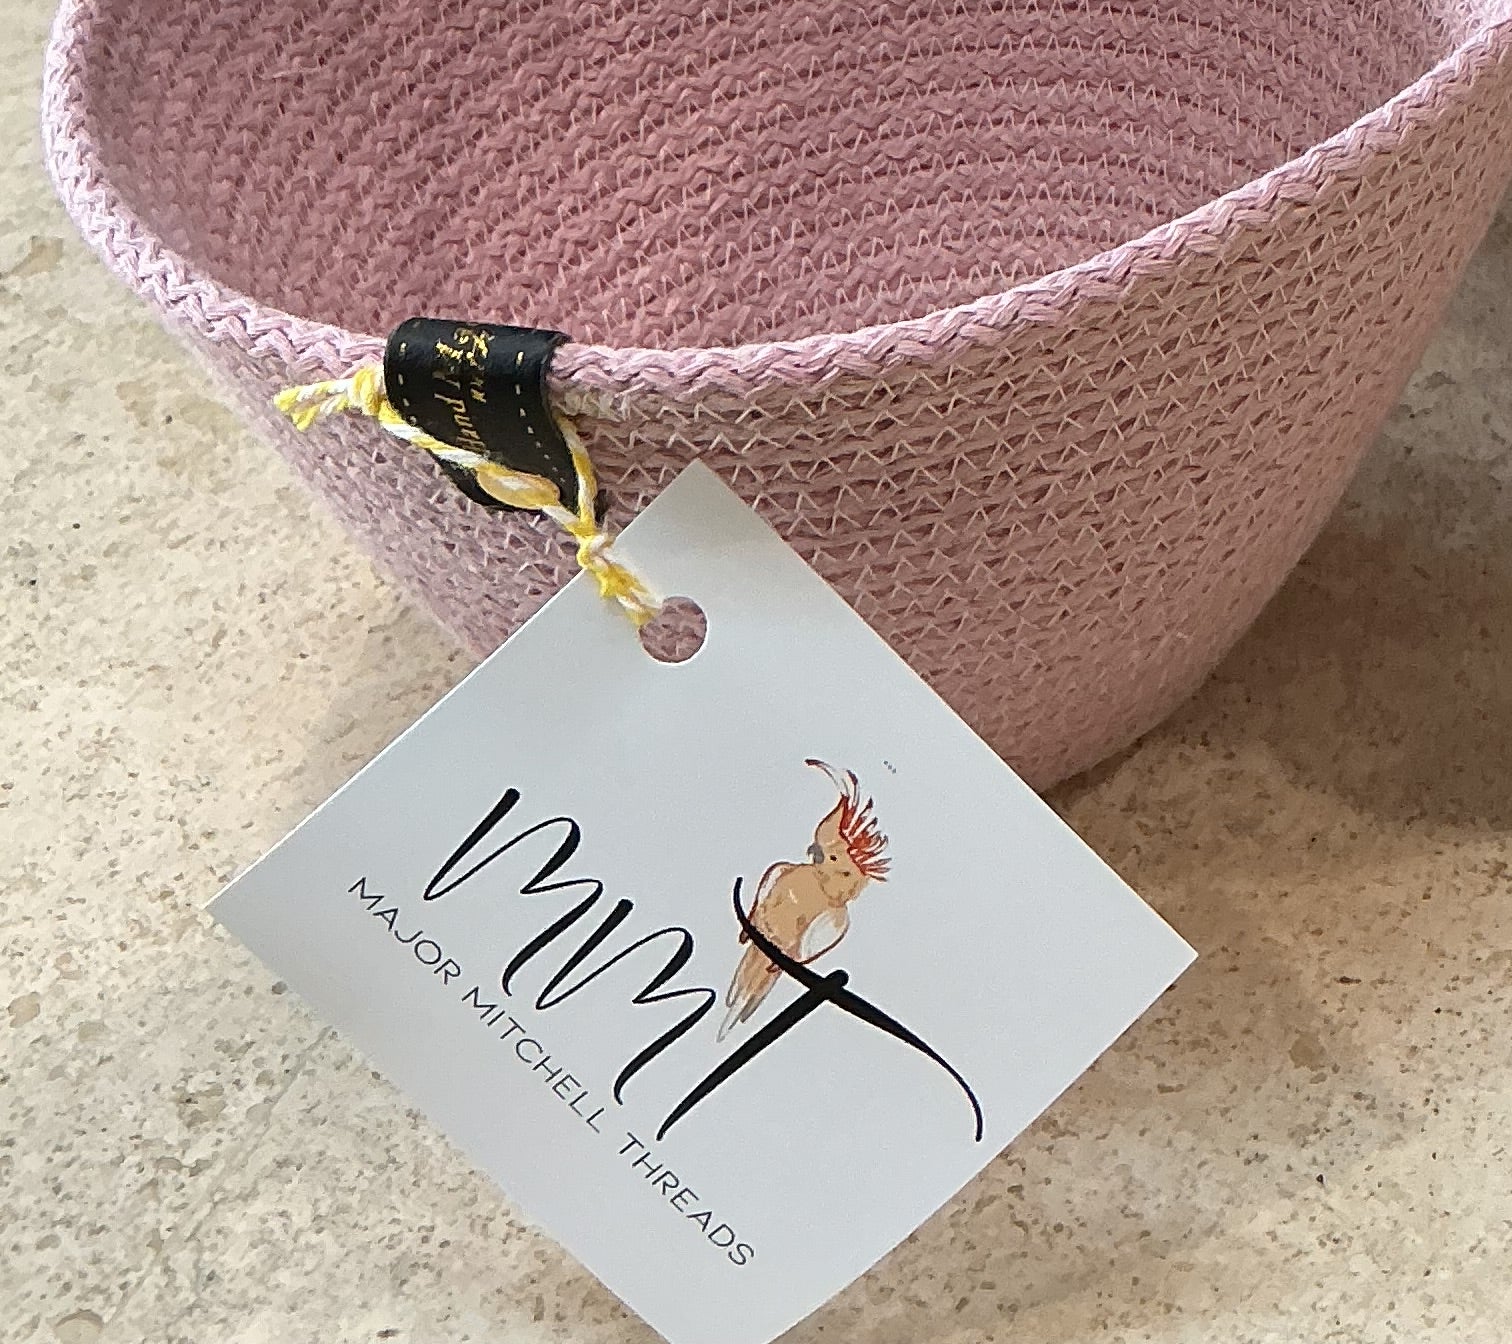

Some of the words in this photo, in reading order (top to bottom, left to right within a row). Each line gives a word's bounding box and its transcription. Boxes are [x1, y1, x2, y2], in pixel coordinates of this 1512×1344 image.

[348, 877, 461, 985] MAJOR
[461, 986, 603, 1134] MITCHELL
[619, 1135, 754, 1265] THREADS
